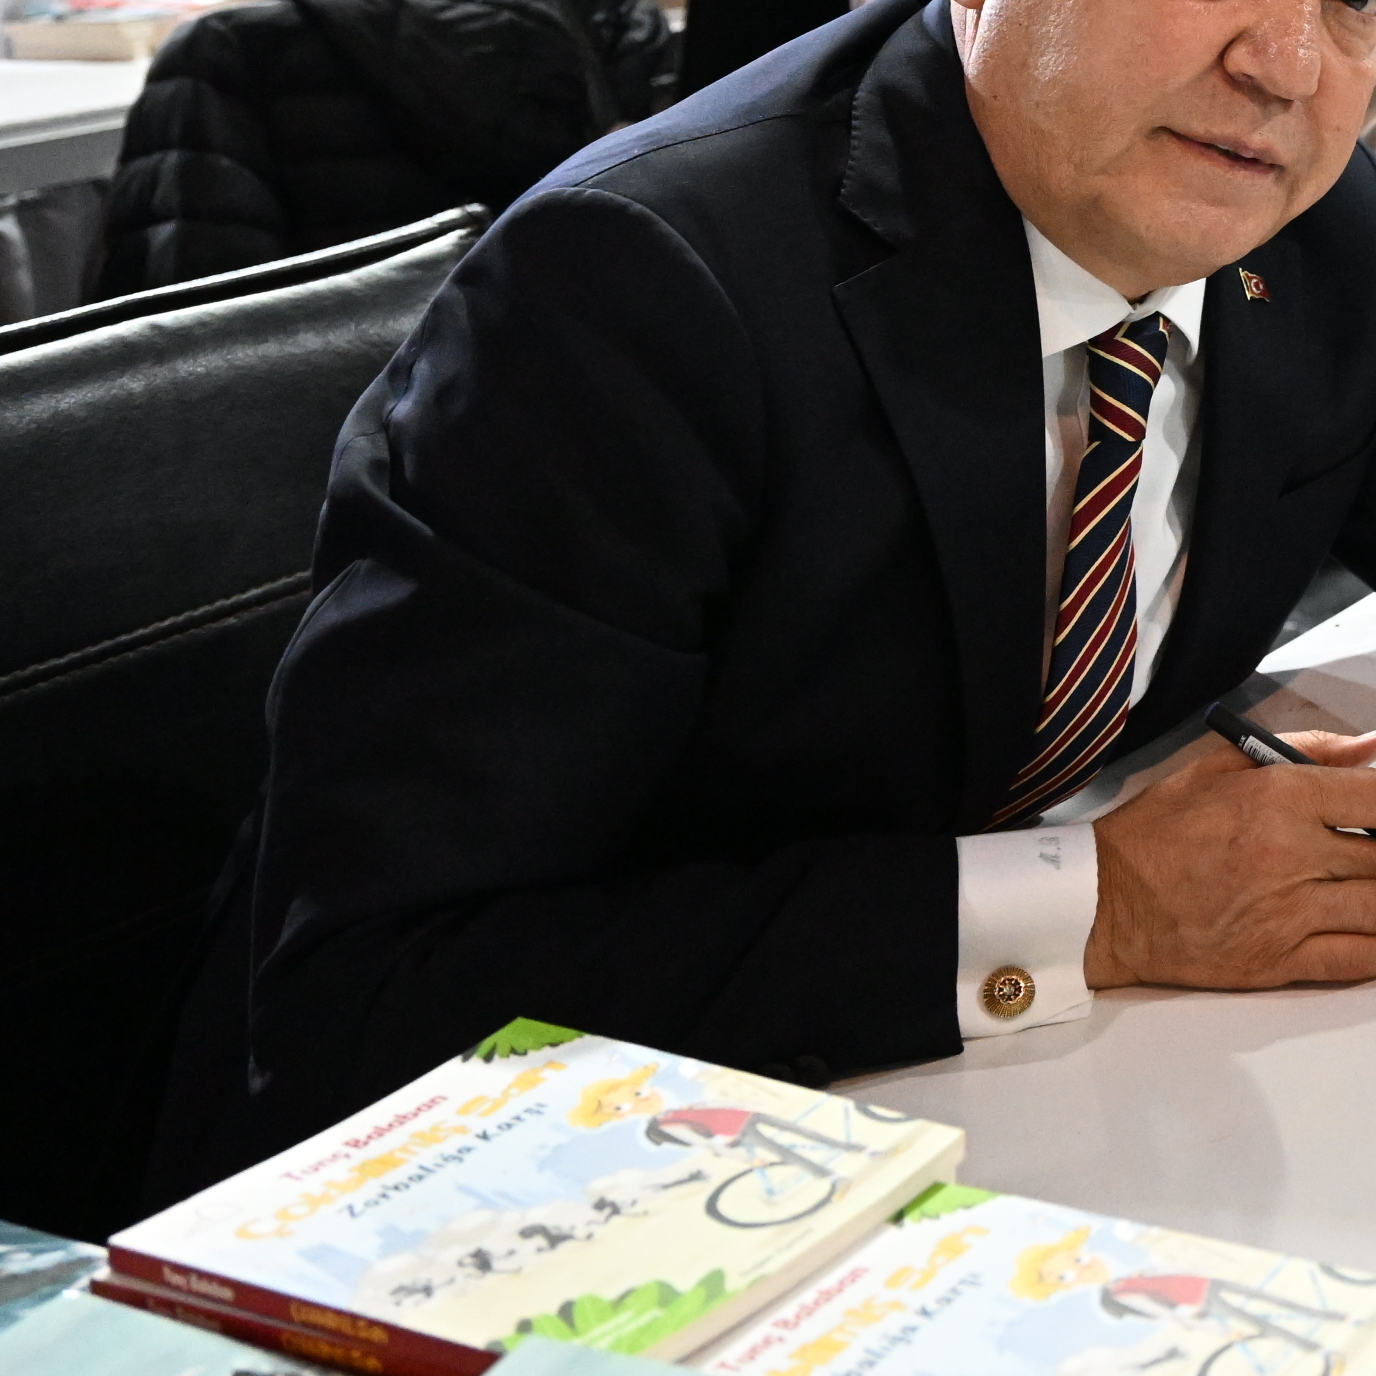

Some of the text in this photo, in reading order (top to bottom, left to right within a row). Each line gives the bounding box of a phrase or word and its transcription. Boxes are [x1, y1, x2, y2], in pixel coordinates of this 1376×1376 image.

[280, 1093, 449, 1183] Tunç Balaban
[338, 1101, 549, 1219] Zorbalığa Karşı
[780, 1264, 871, 1330] Balaban
